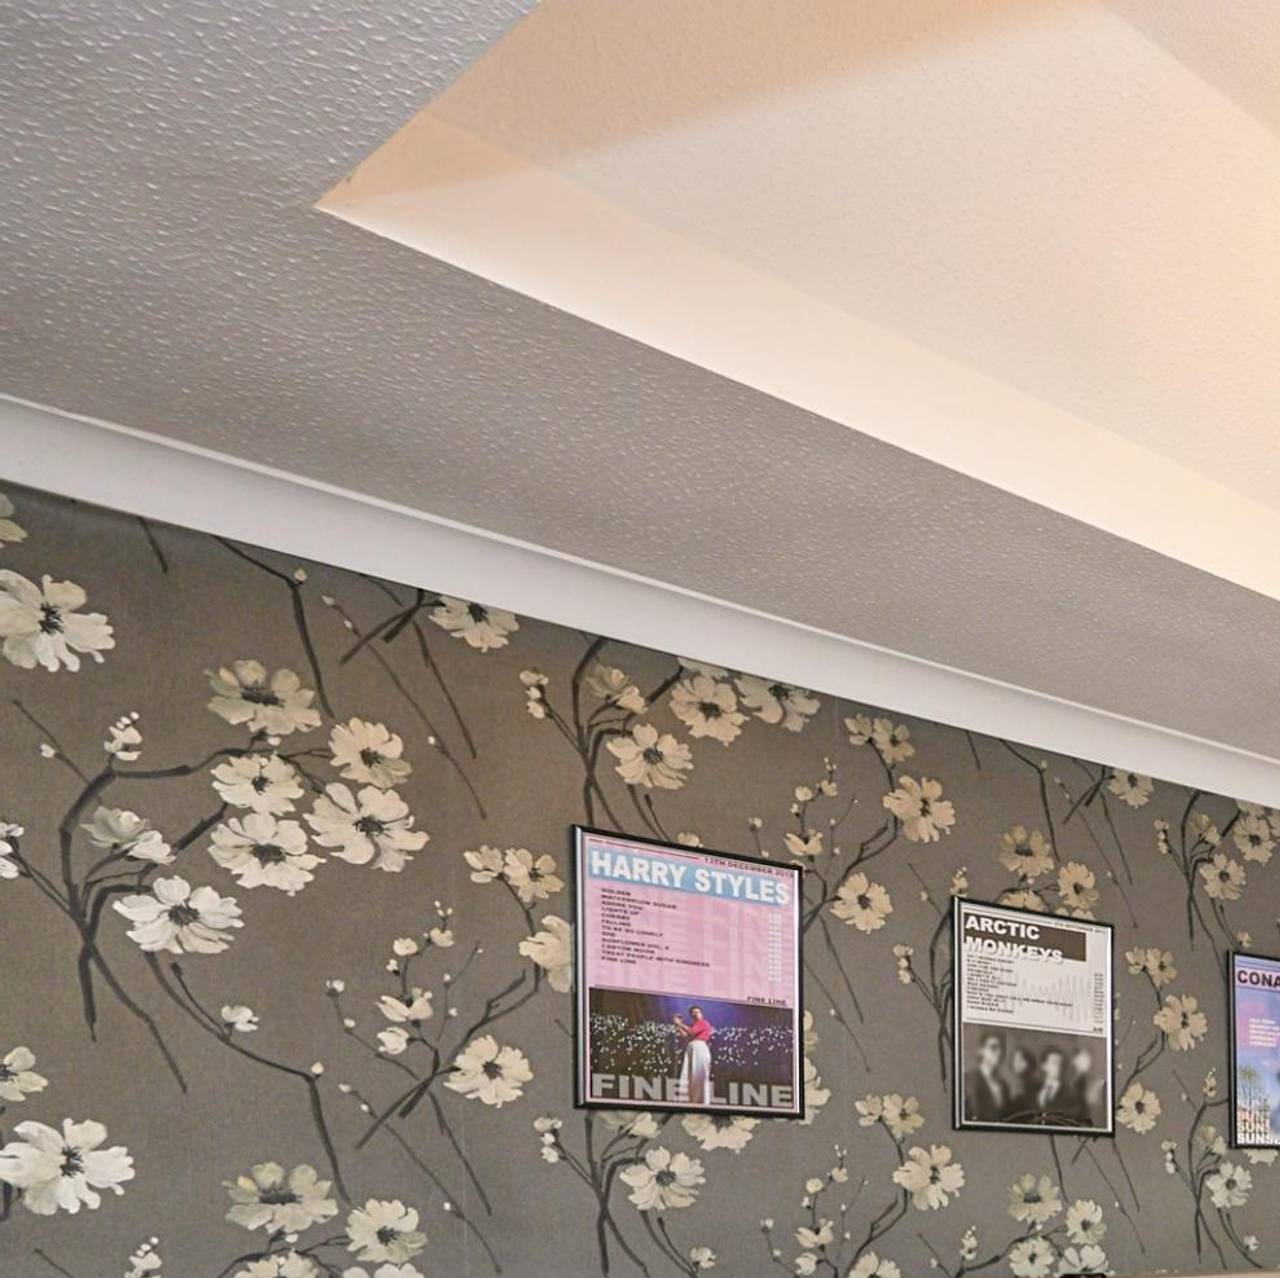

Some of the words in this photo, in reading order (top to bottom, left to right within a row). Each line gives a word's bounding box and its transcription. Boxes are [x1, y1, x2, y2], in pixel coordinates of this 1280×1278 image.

[591, 850, 687, 888] HARRY
[694, 868, 789, 905] STYLES
[965, 915, 1040, 940] ARCTIC
[965, 936, 1064, 965] MONKEYS
[591, 1072, 688, 1102] FINE
[708, 1081, 793, 1108] LINE
